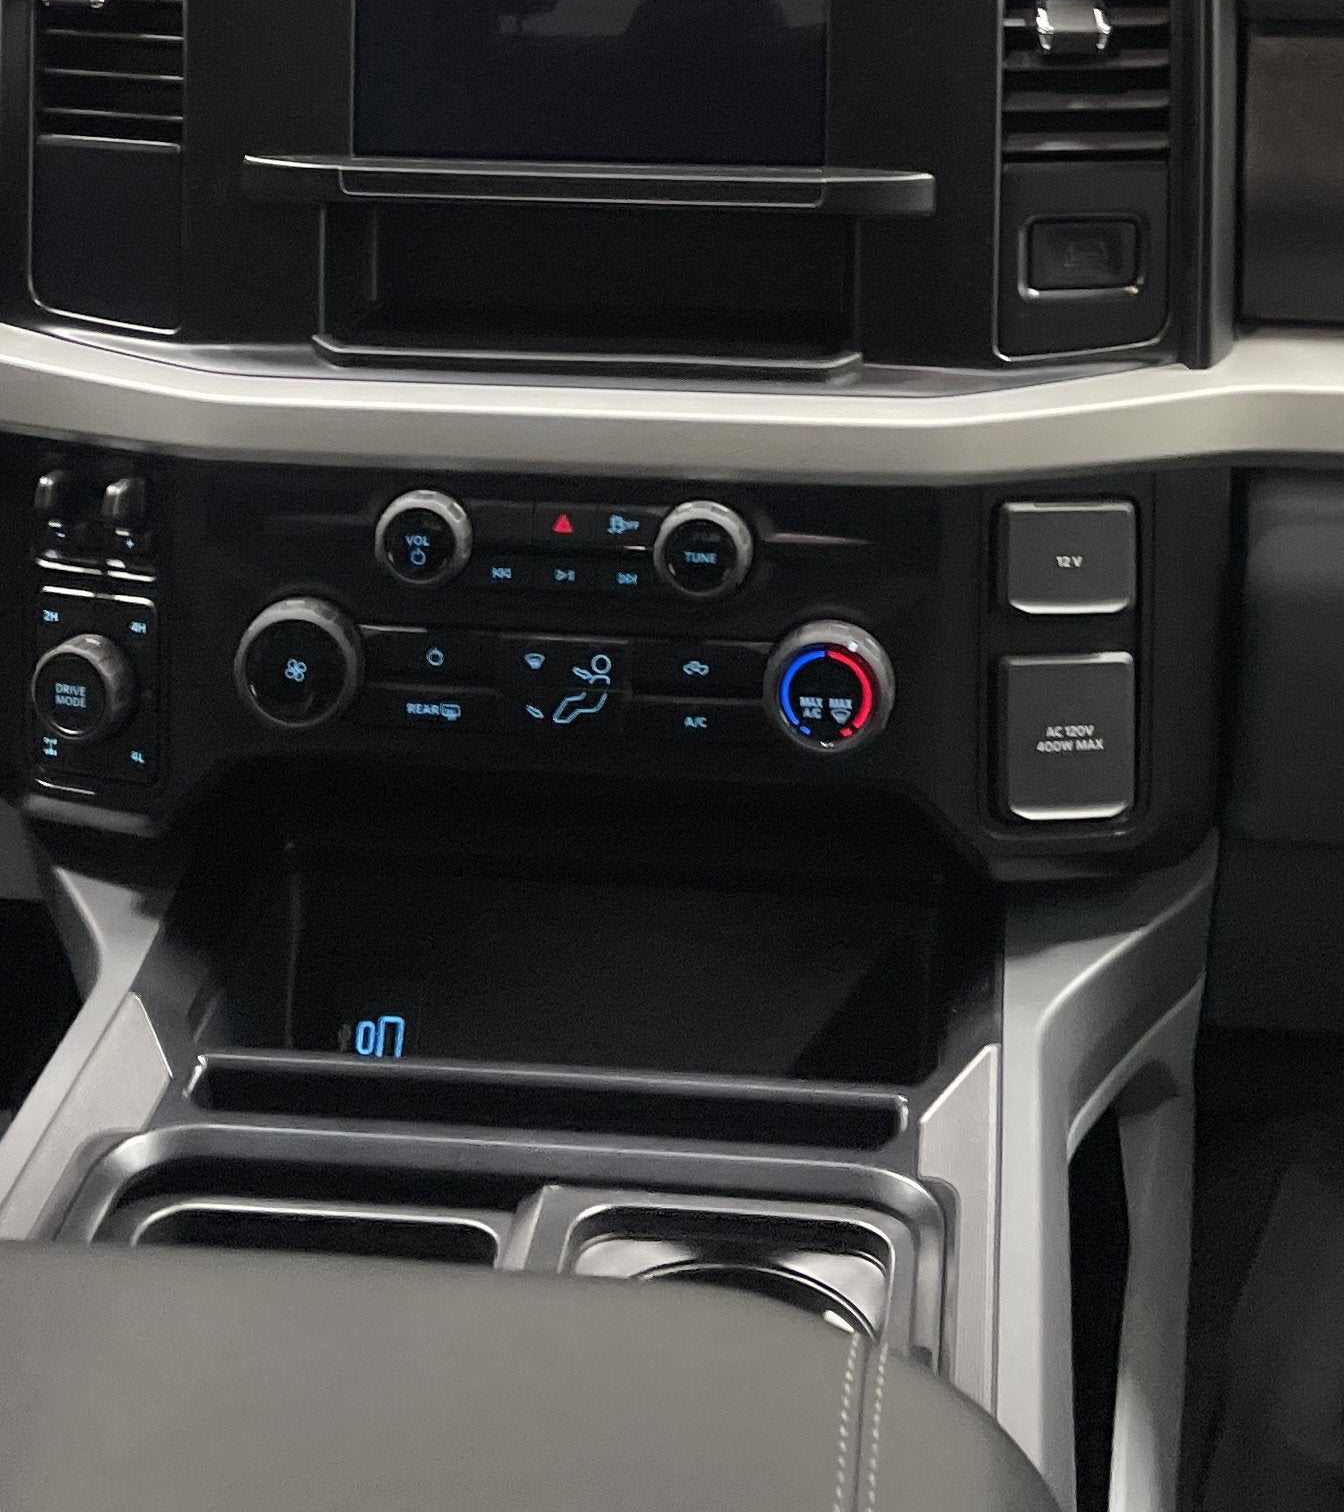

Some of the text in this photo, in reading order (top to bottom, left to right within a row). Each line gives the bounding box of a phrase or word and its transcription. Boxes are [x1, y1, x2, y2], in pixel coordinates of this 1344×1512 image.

[405, 535, 430, 547] VOL
[683, 551, 717, 564] TUNE
[55, 682, 86, 697] DRIVE
[55, 695, 86, 708] MODE
[406, 703, 439, 715] REAR
[1046, 724, 1095, 738] AC 120V
[1036, 738, 1104, 752] 400W MAX
